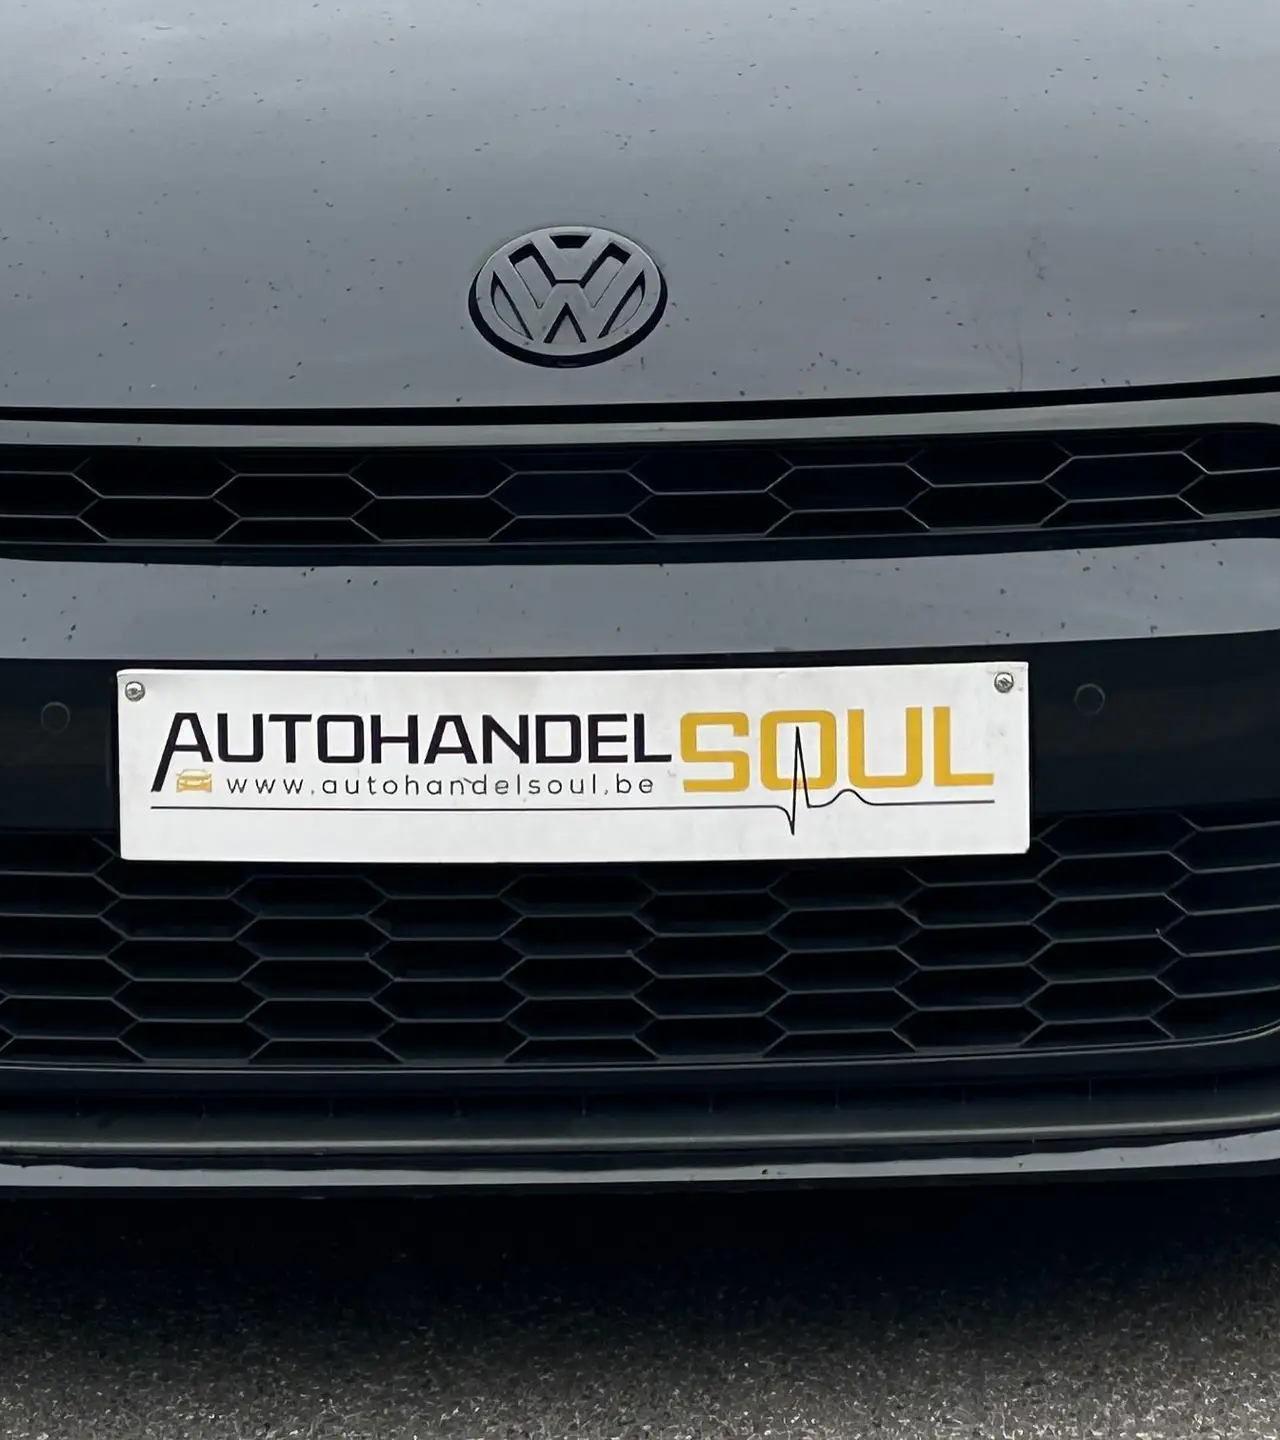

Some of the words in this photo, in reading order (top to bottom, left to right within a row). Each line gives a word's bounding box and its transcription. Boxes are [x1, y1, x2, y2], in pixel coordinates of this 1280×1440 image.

[150, 712, 672, 793] AUTOHANDEL
[678, 706, 996, 793] SOUL
[226, 772, 655, 796] www.autohandelsoul.be
